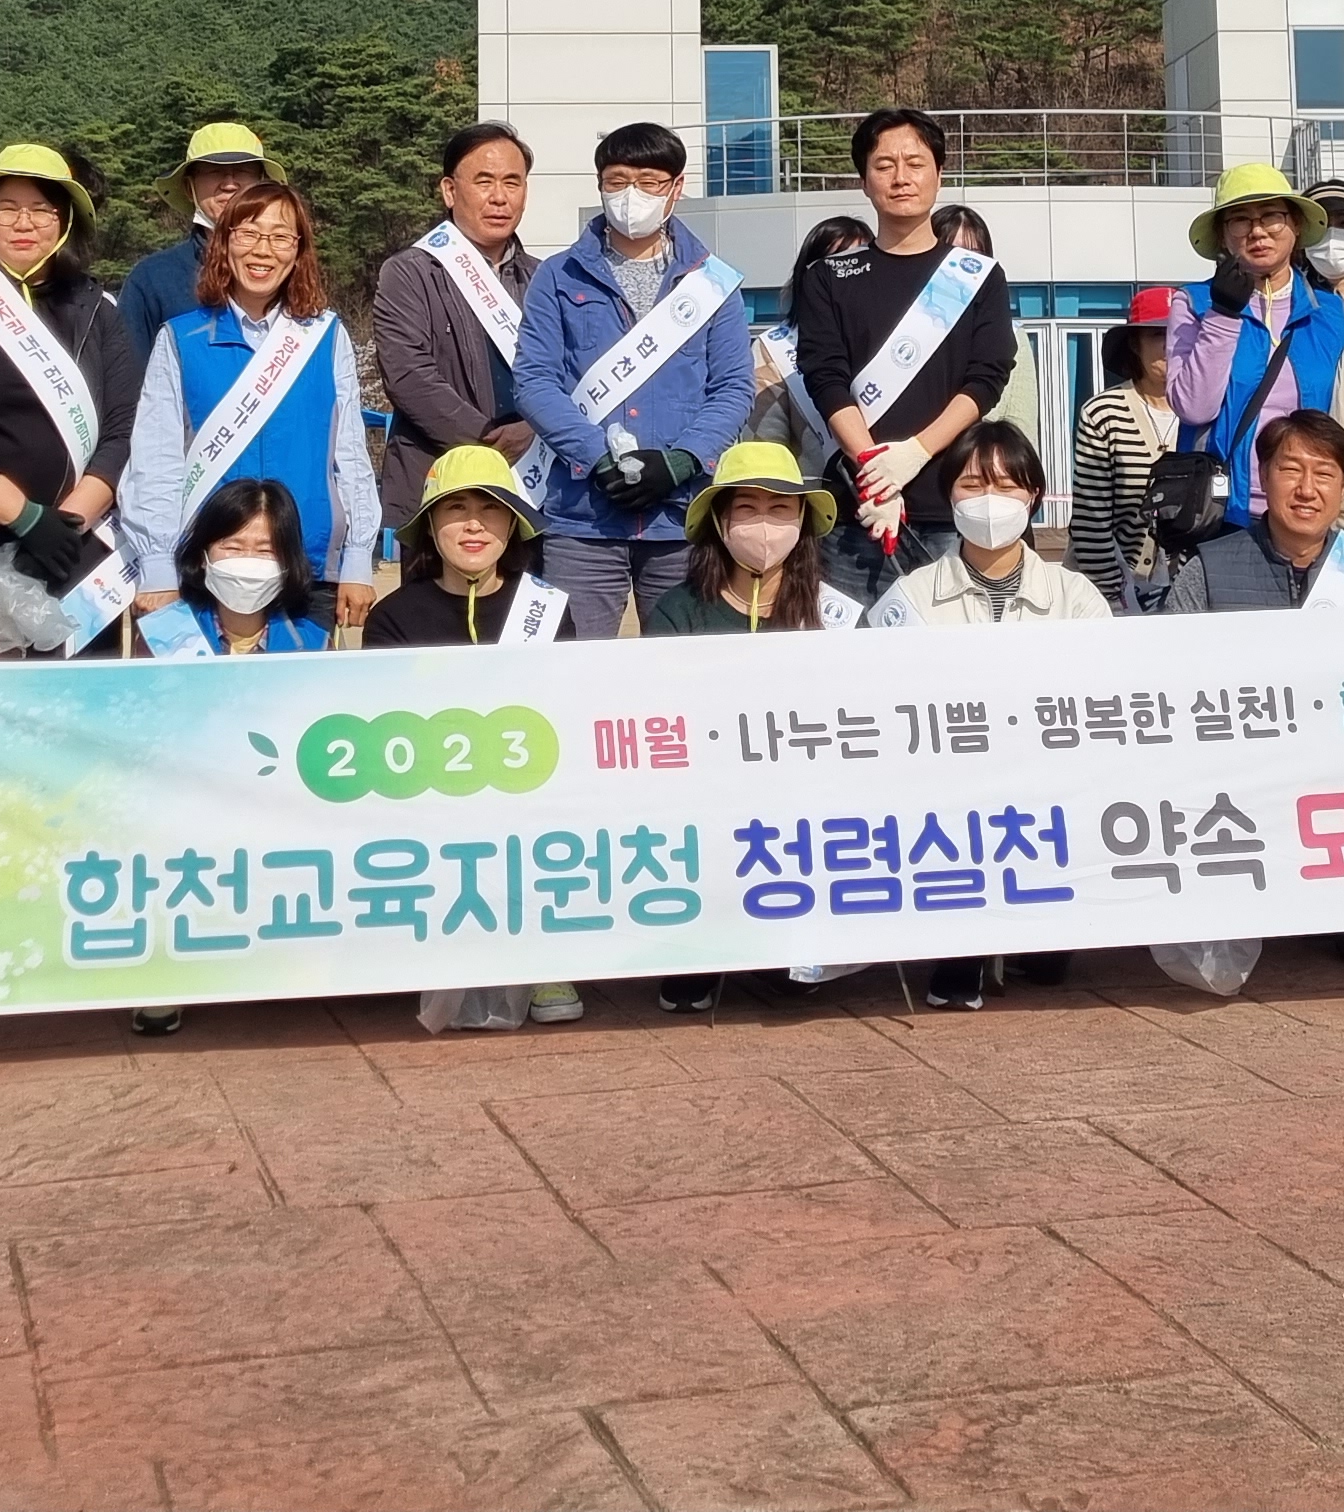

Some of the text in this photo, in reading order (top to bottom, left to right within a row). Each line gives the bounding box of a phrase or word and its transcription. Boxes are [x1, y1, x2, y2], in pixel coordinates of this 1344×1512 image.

[455, 253, 498, 310] 양심지킴
[18, 334, 51, 363] 내가
[43, 364, 75, 406] 먼저,
[255, 335, 301, 396] 양심지킴
[234, 392, 261, 429] 내가
[199, 426, 235, 462] 먼저,
[327, 731, 529, 777] 2023
[594, 716, 690, 769] 매월
[739, 706, 880, 762] 나누는
[894, 702, 989, 754] 기쁨
[1034, 691, 1175, 749] 행복한
[1190, 685, 1298, 740] 실천!
[64, 823, 702, 961] 합천교육지원청
[733, 803, 1075, 920] 청렴실천
[1100, 791, 1267, 893] 약속
